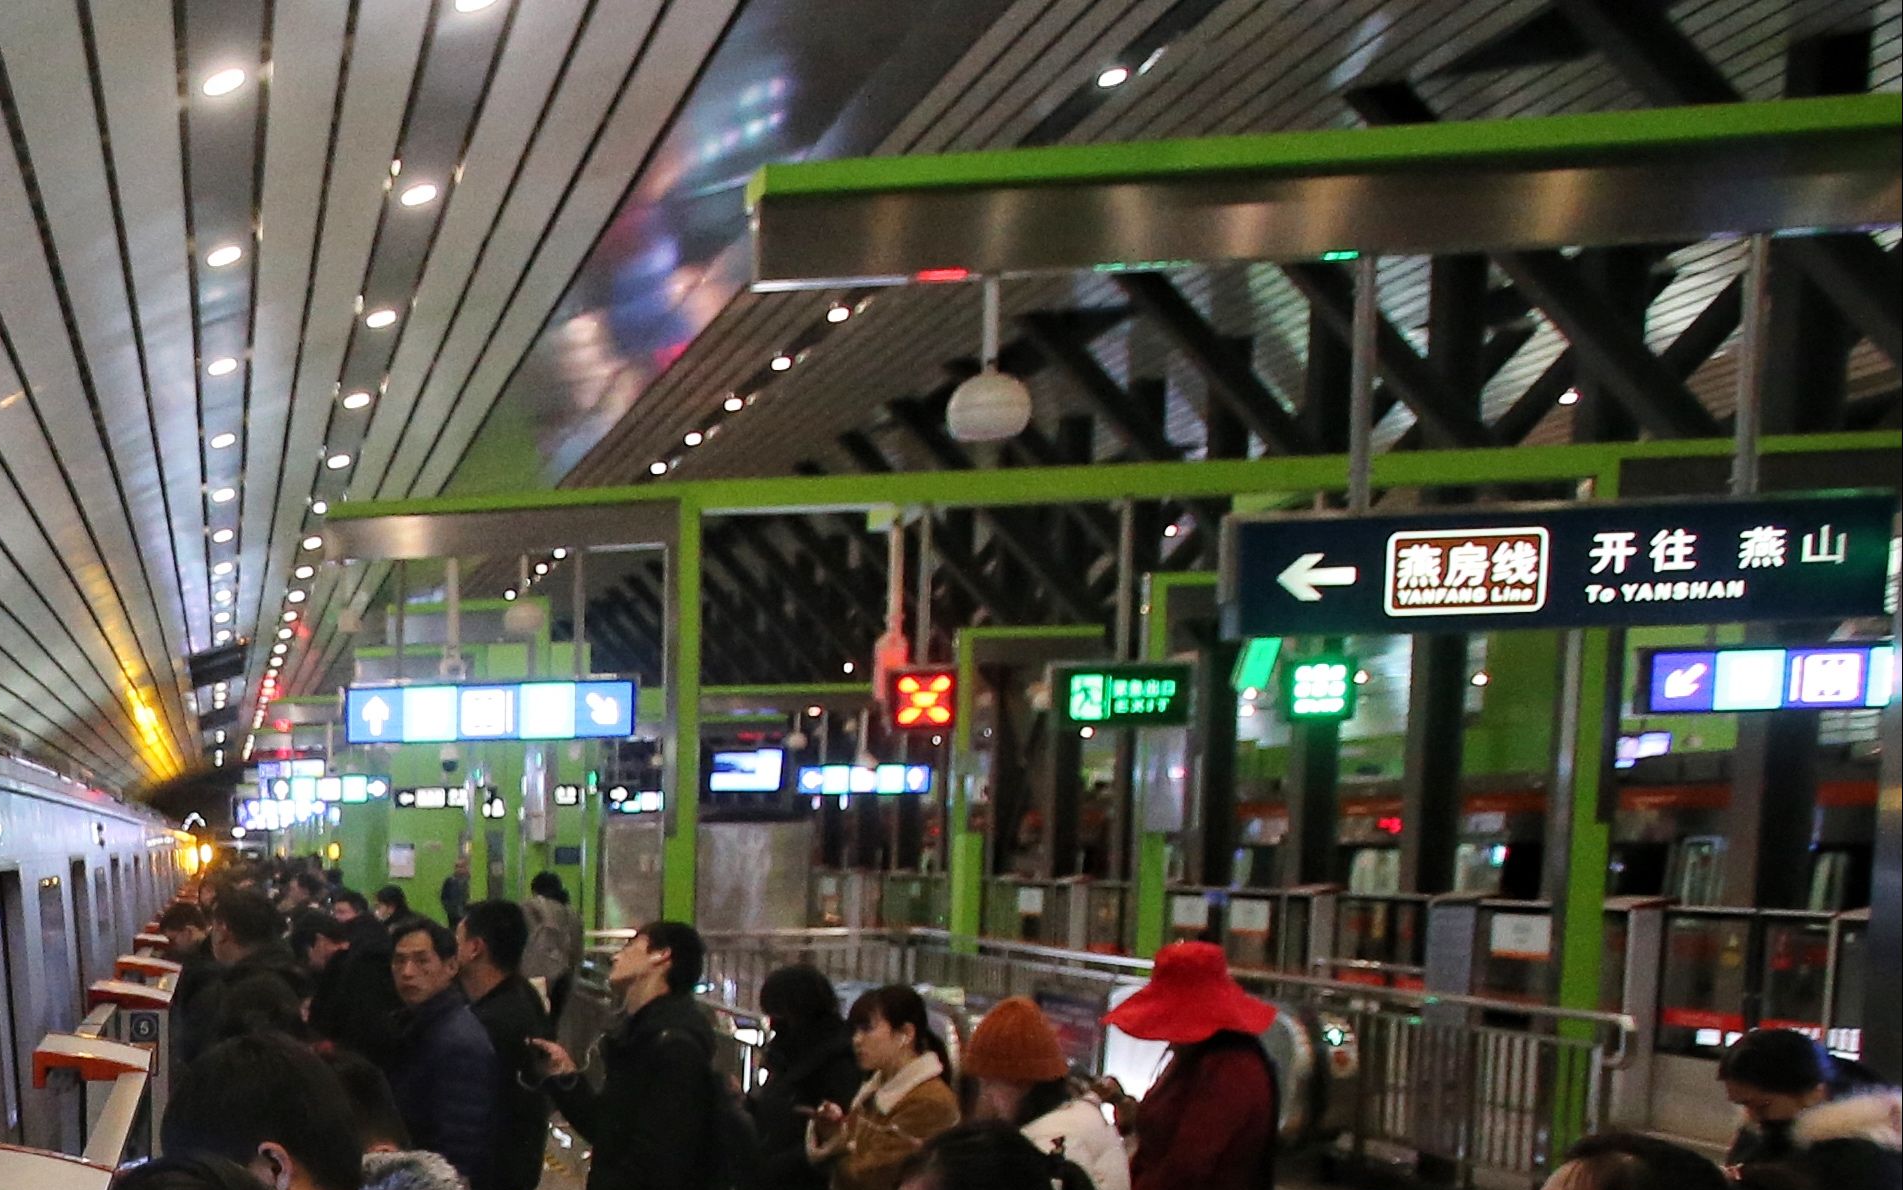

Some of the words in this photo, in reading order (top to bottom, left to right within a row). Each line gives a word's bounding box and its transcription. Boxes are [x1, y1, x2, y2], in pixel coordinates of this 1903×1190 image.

[1589, 528, 1697, 574] 开往
[1738, 524, 1847, 570] 燕山
[1397, 540, 1539, 588] 燕房线
[1397, 586, 1488, 606] YANFANG
[1491, 585, 1534, 604] Line
[1585, 584, 1615, 604] To
[1620, 579, 1745, 603] YANSHAN
[1113, 697, 1170, 714] EXIT
